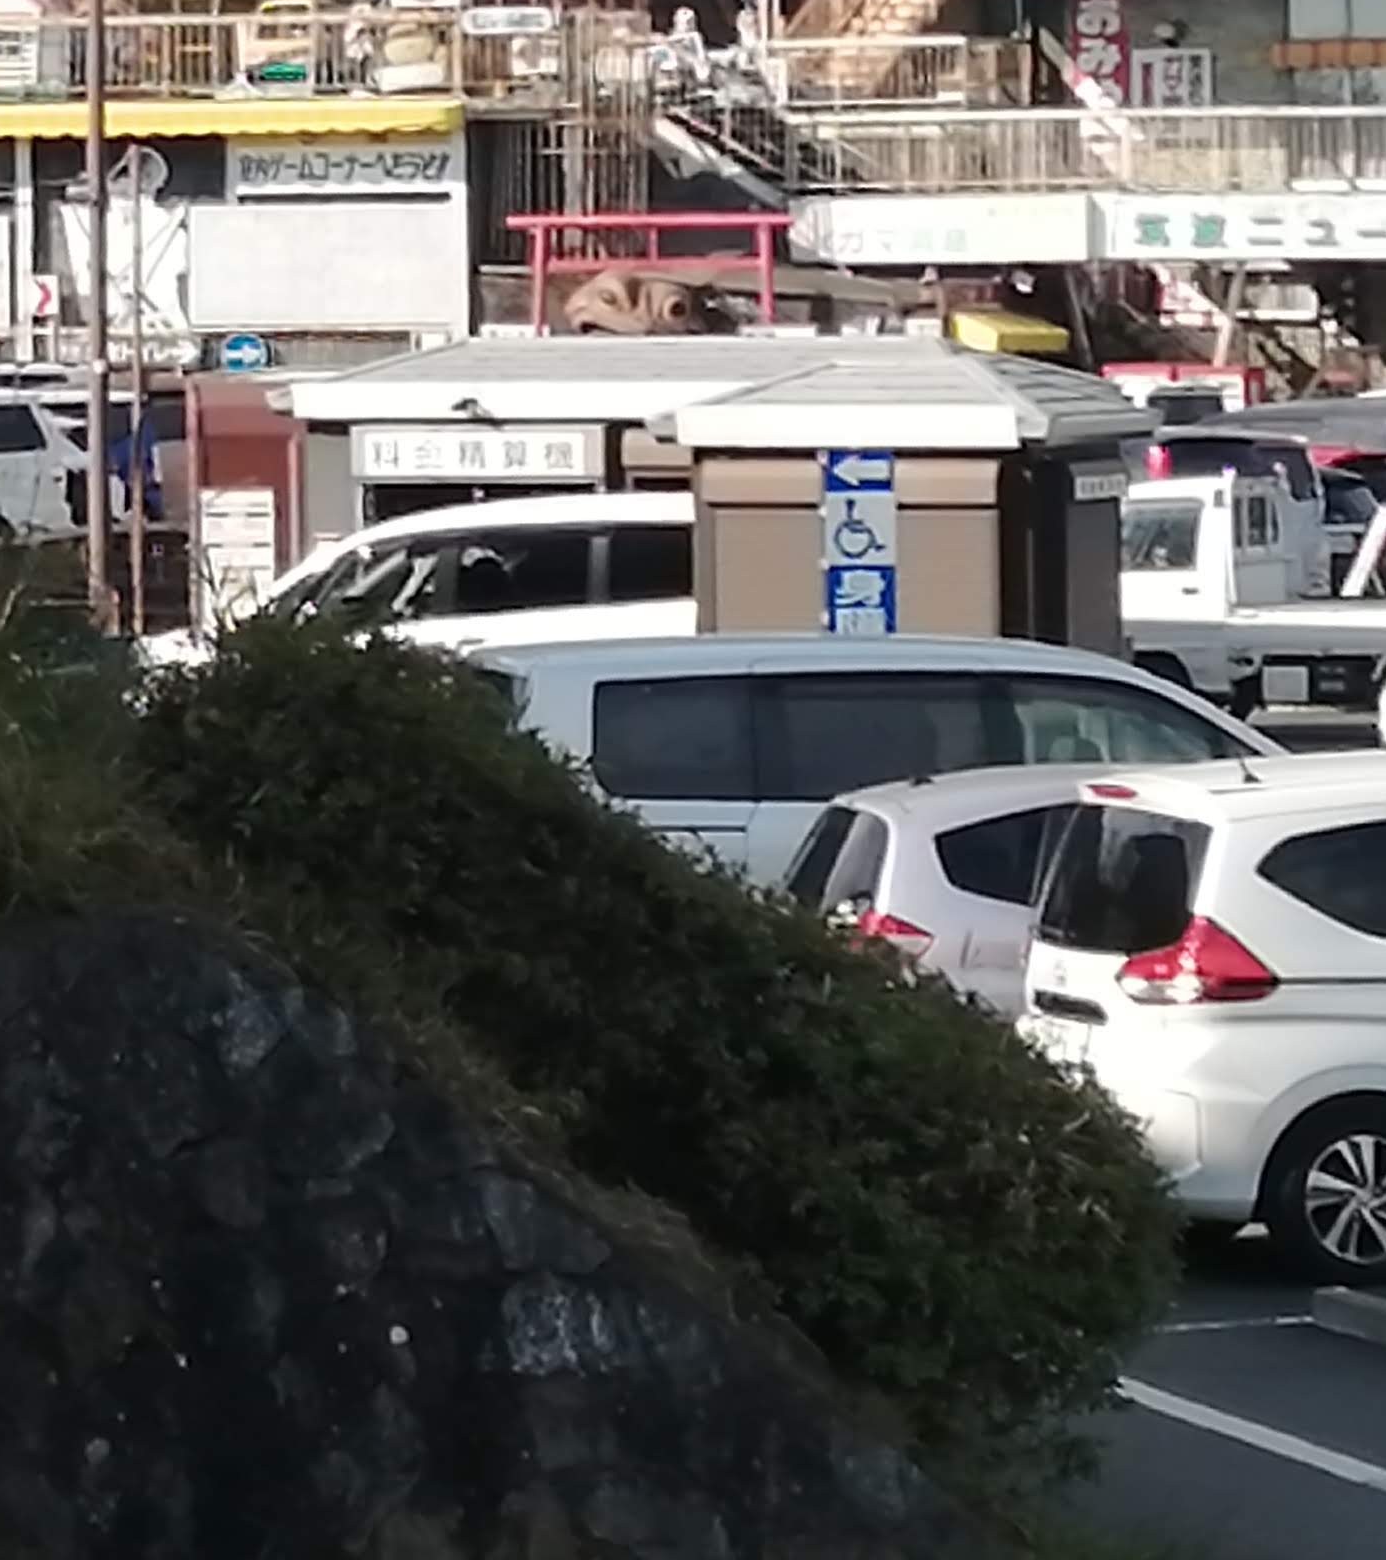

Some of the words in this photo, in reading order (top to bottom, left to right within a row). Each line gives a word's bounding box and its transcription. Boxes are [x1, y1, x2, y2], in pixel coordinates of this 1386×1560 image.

[371, 439, 575, 470] 料金精算機
